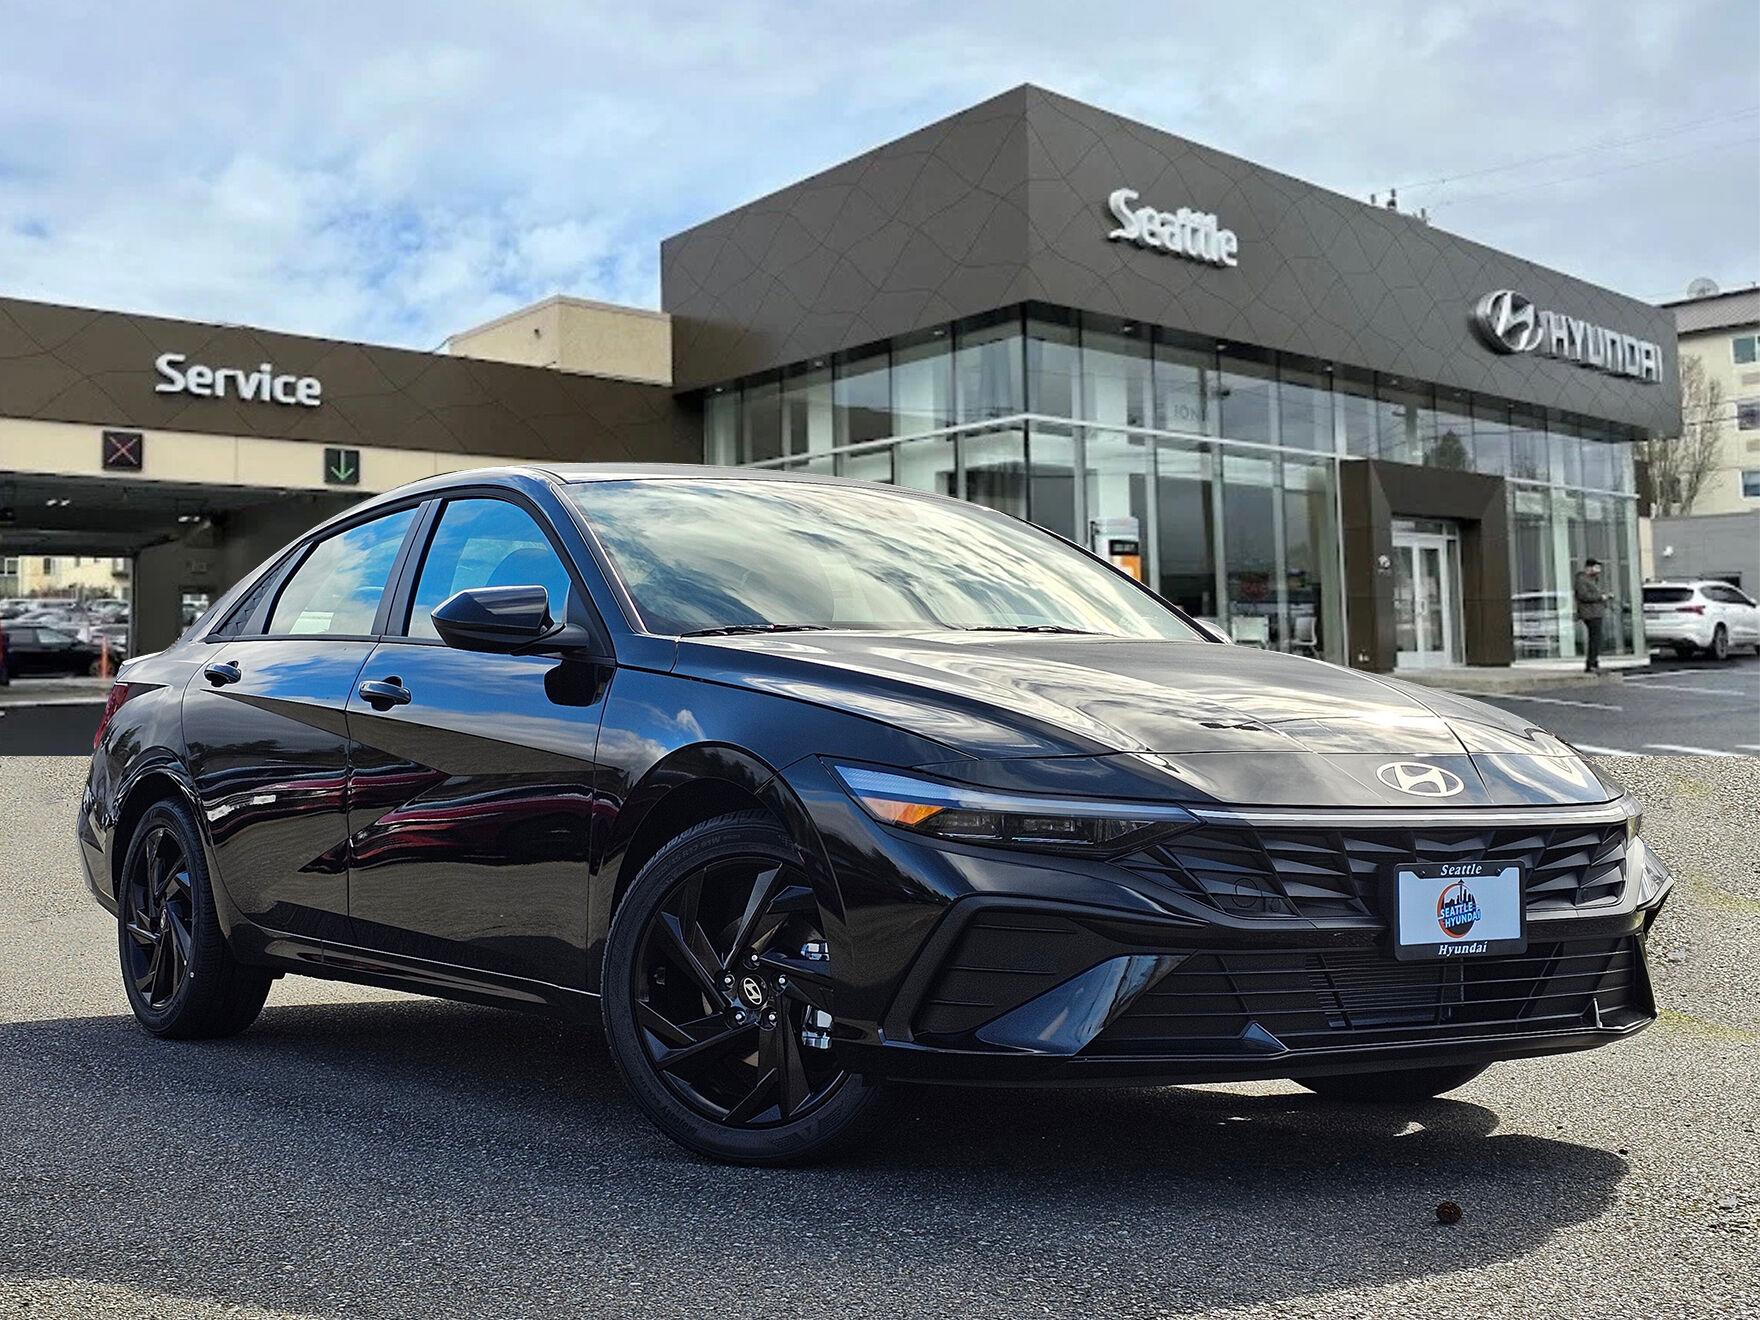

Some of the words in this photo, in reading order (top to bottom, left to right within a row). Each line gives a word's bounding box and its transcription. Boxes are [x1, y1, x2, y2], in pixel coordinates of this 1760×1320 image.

[1109, 188, 1238, 267] Seattle
[1541, 311, 1663, 383] HYUNDAI
[155, 353, 322, 407] Service
[1440, 863, 1482, 876] Seattle
[1440, 902, 1473, 919] SEATTLE
[1445, 908, 1482, 928] HYUNDAI
[1438, 941, 1488, 957] Hyundai
